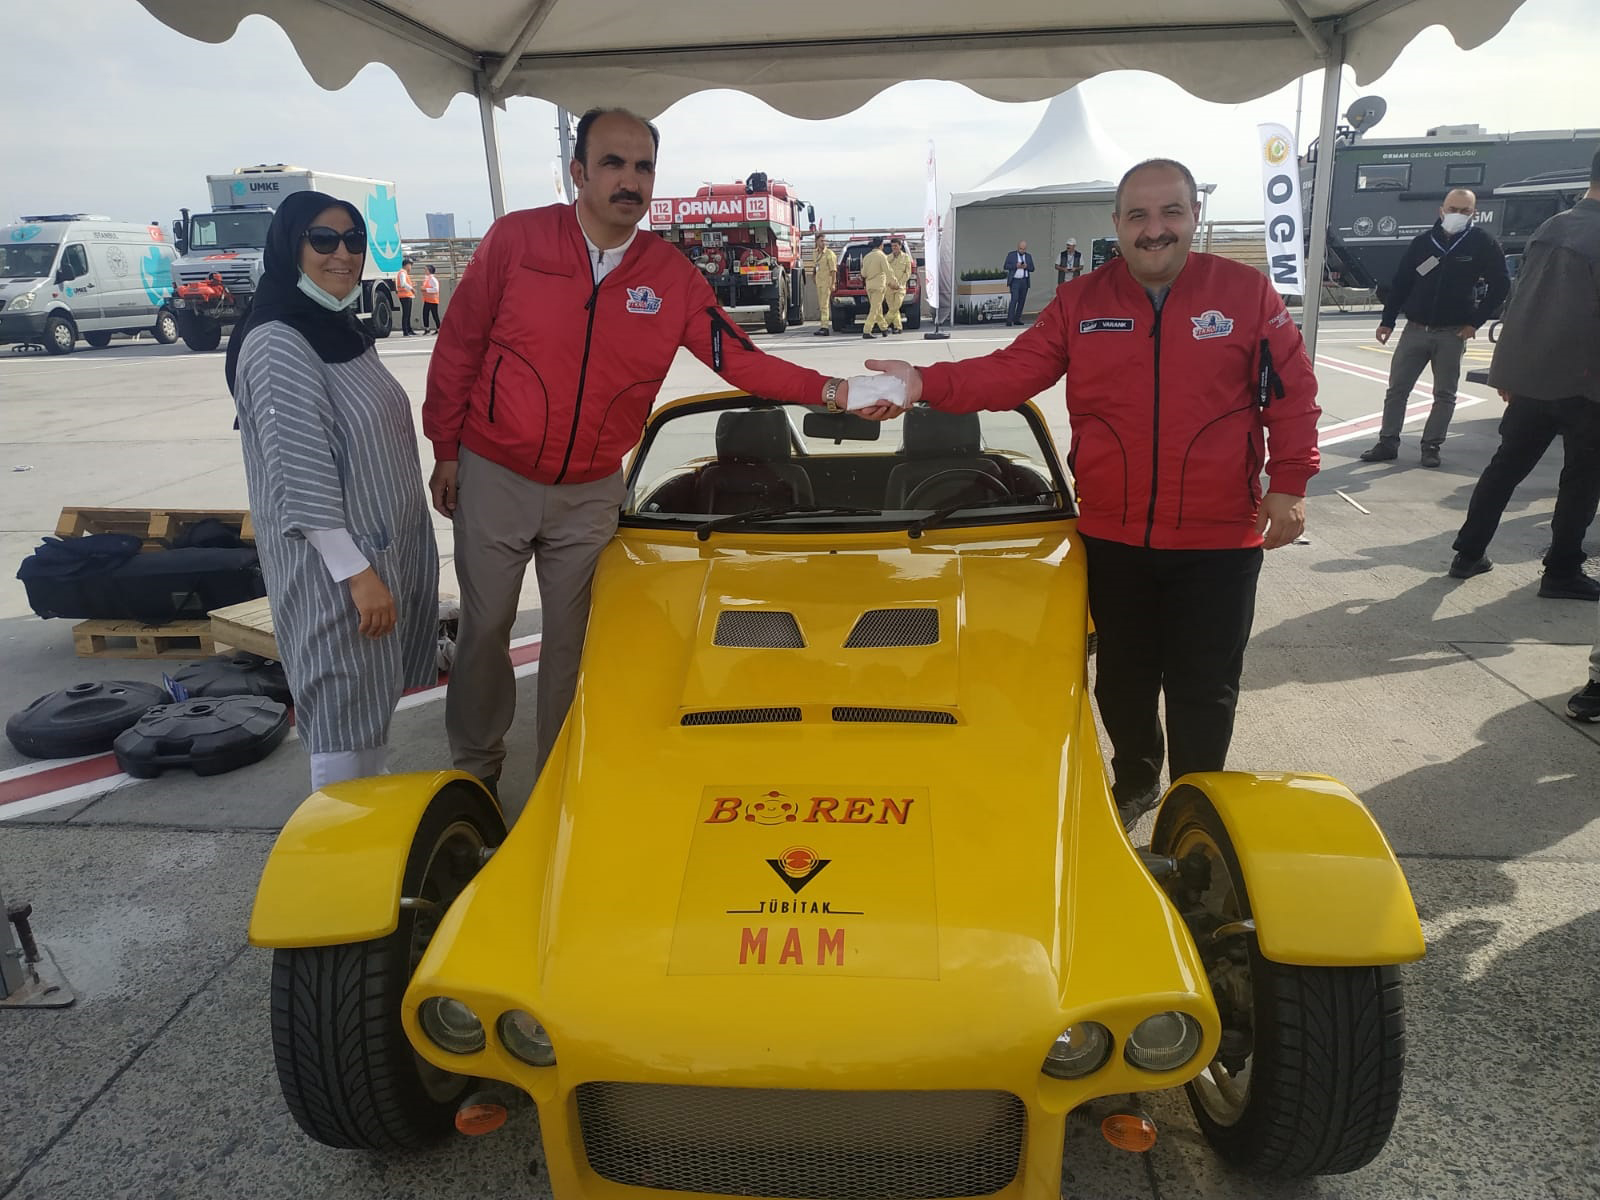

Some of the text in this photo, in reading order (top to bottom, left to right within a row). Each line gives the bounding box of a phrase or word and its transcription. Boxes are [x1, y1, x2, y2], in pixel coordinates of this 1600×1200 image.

[250, 182, 280, 191] UMKE
[653, 203, 669, 214] 112
[679, 200, 742, 215] ORMAN
[749, 200, 764, 211] 112
[1267, 174, 1299, 285] OGM
[760, 898, 831, 914] TÜBİTAK
[739, 927, 846, 967] MAM
